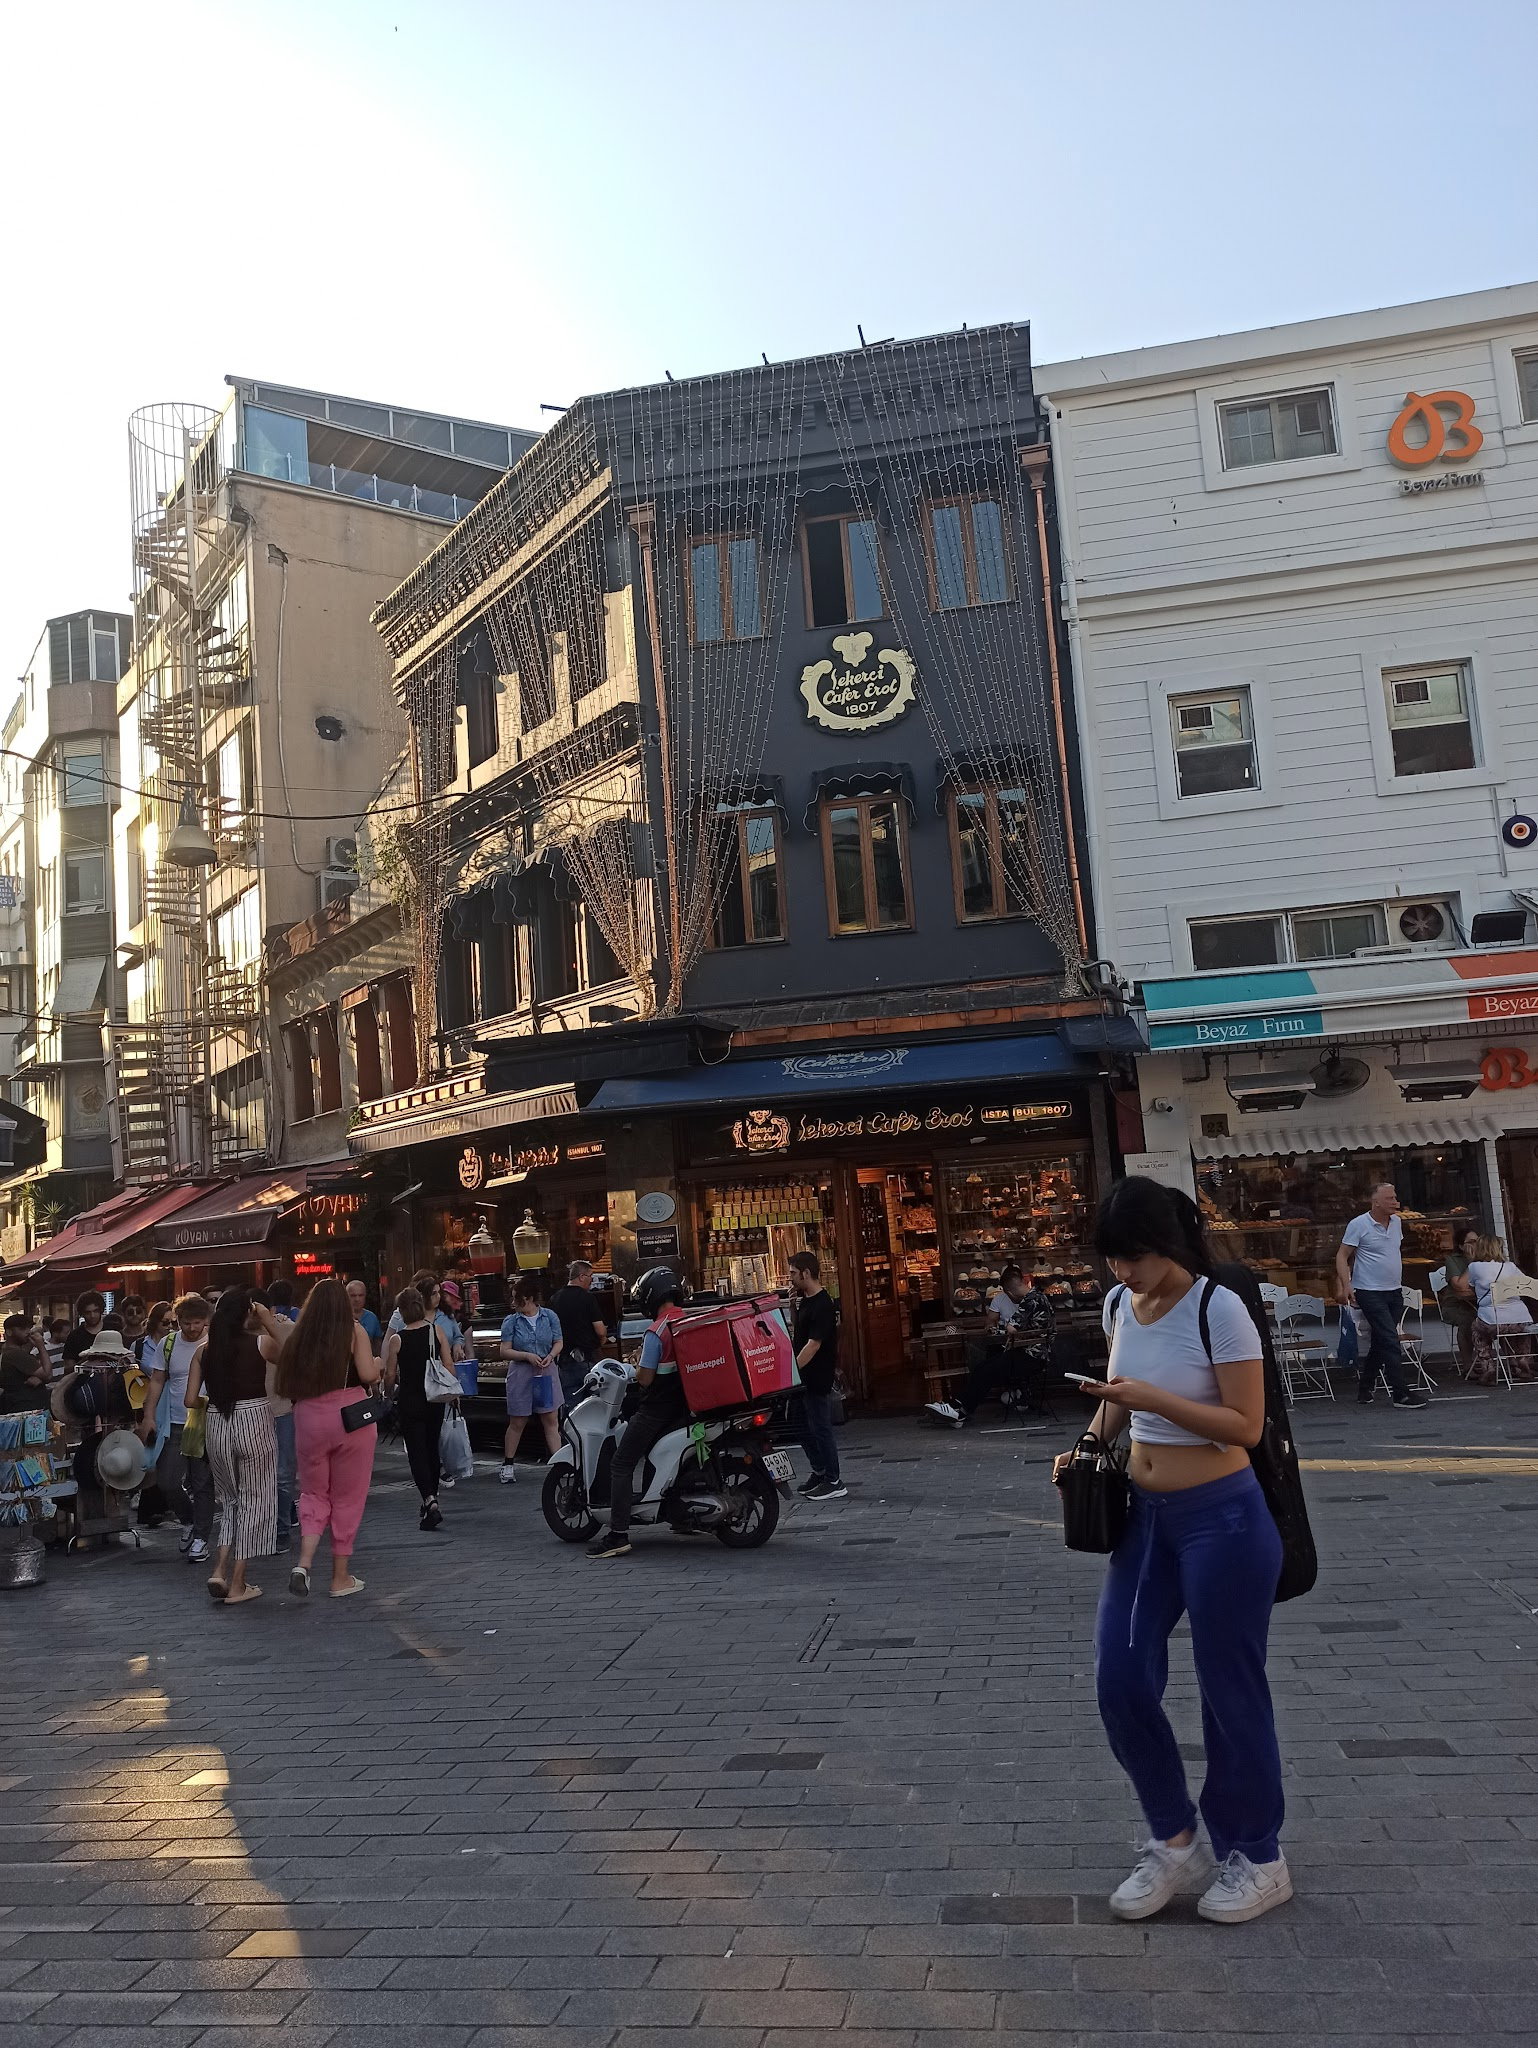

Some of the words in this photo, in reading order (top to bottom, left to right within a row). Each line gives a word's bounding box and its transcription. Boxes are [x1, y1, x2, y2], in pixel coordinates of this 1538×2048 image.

[822, 686, 861, 706] Cafer
[864, 678, 898, 698] Erol
[845, 701, 877, 715] 1807
[1483, 996, 1538, 1015] Beyaz
[1196, 1022, 1249, 1041] Beyaz
[1262, 1017, 1306, 1035] Fırın
[1042, 1105, 1068, 1115] 1807
[867, 1110, 922, 1136] Cafer
[925, 1105, 974, 1130] Erol
[1206, 1121, 1224, 1133] 23
[685, 1356, 725, 1373] Yemeksepeti
[764, 1457, 774, 1467] 34
